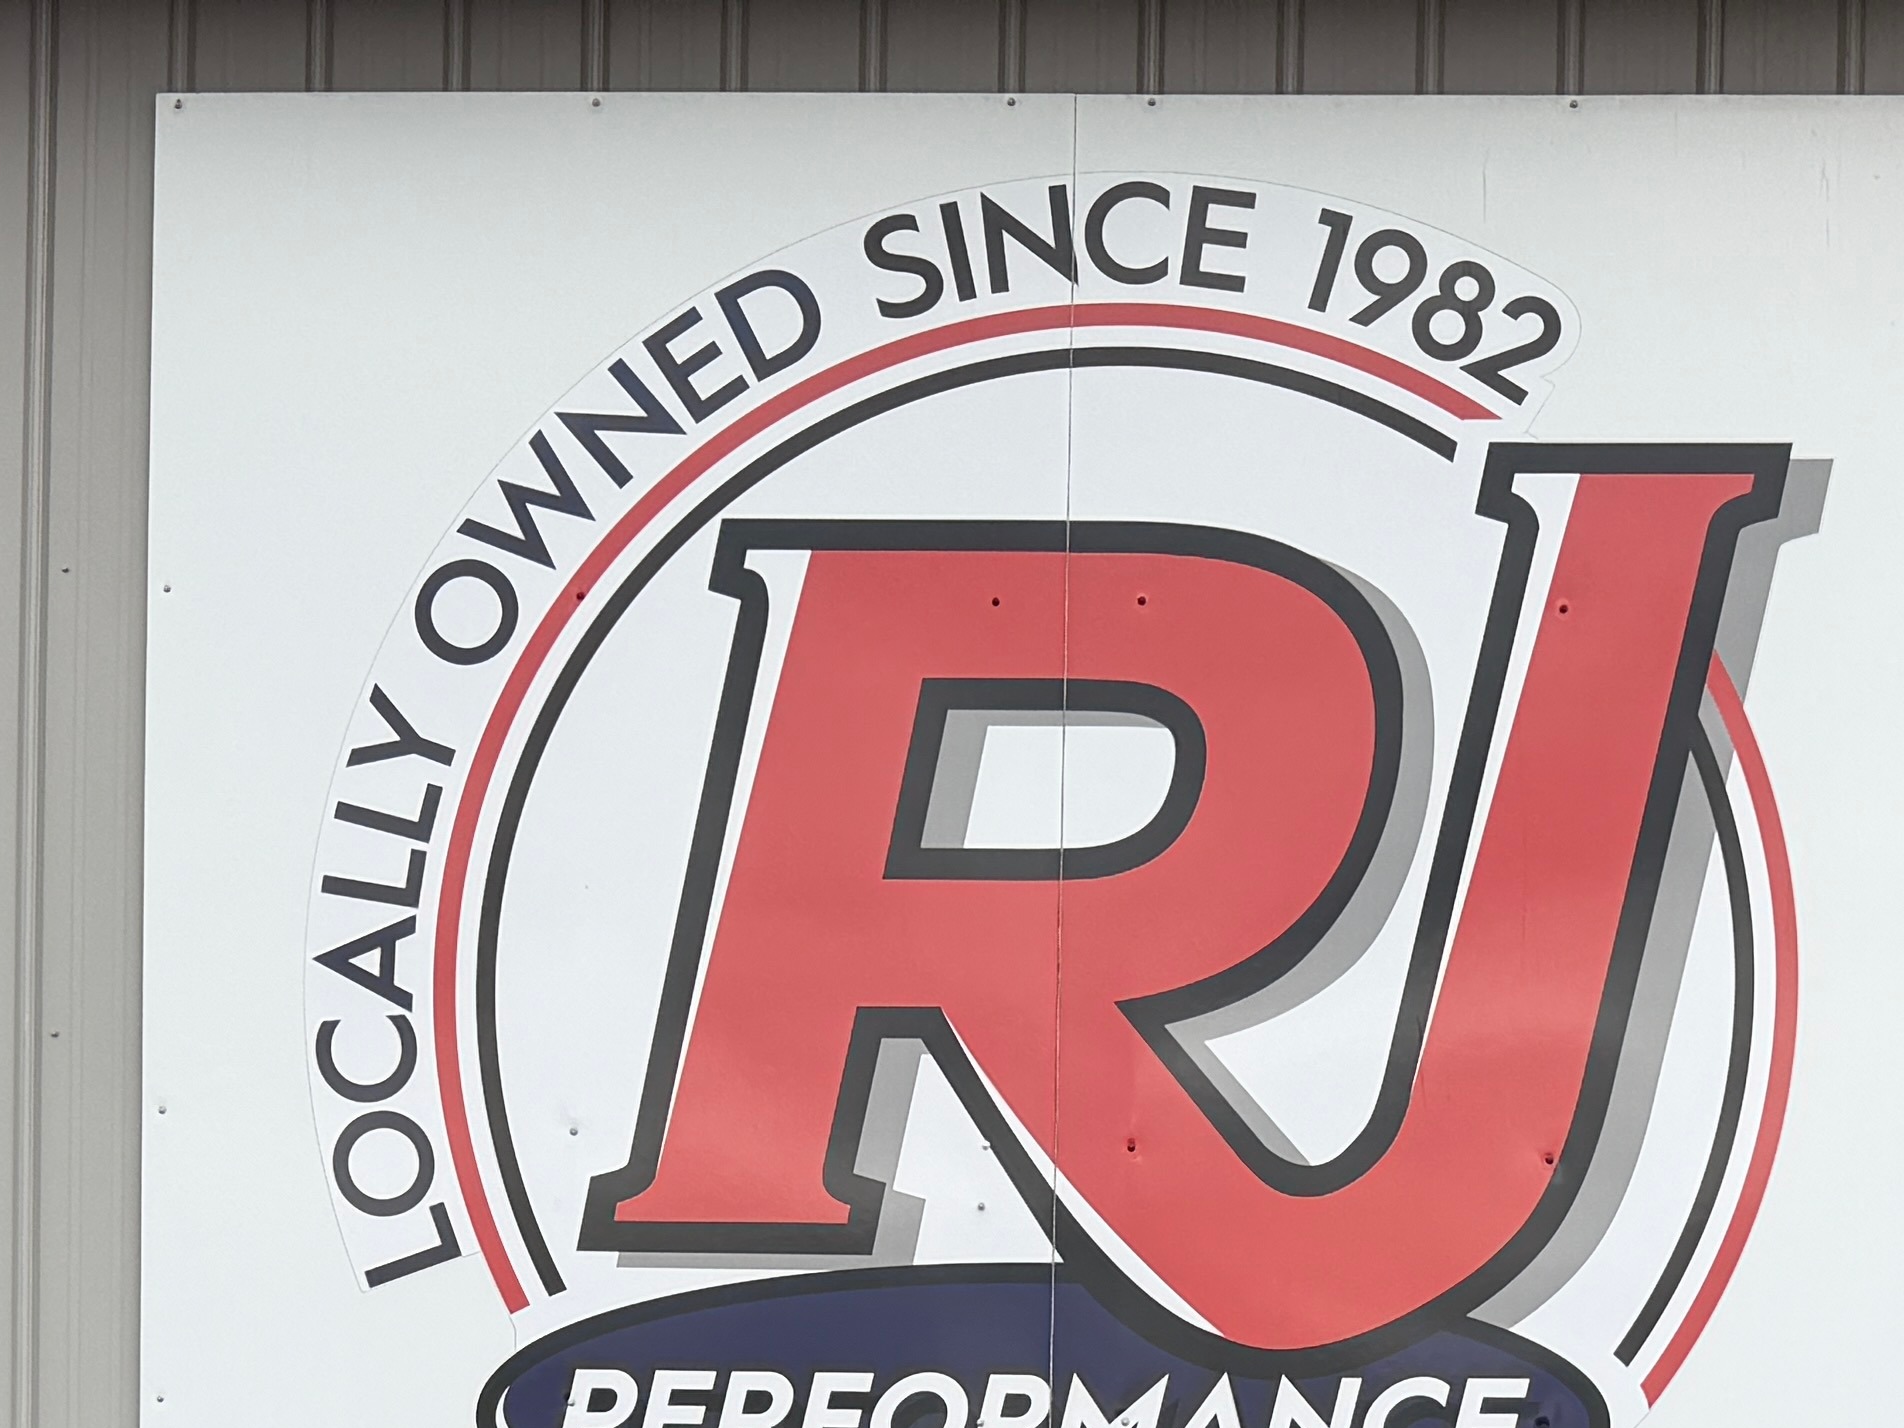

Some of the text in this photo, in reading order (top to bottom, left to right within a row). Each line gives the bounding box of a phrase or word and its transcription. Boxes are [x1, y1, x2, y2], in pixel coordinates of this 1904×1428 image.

[312, 180, 1562, 1288] LOCALLY OWNED SINCE 1982
[577, 442, 1793, 1373] RJ
